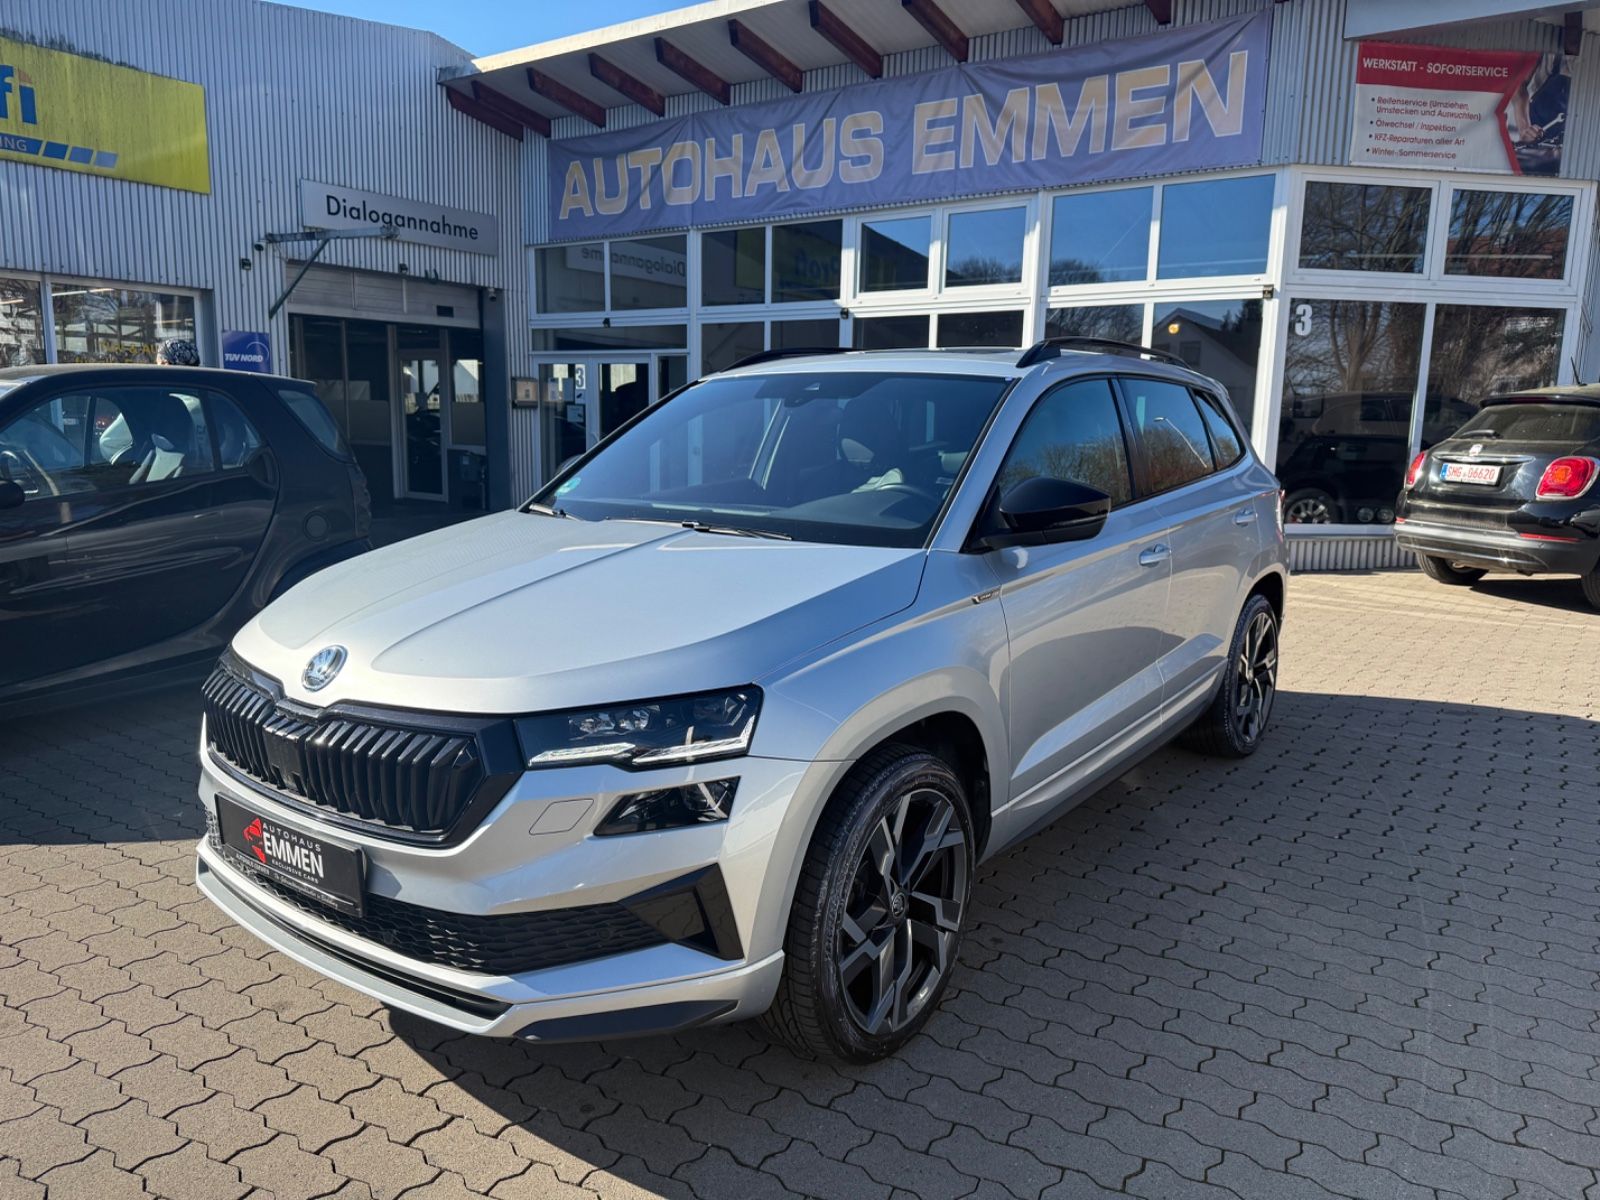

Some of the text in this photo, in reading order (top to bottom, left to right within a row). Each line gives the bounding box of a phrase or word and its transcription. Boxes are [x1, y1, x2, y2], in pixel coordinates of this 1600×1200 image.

[1362, 57, 1418, 72] WERKSTATT
[1426, 62, 1509, 78] SOFORTSERVICE
[1377, 96, 1428, 108] Reifenservice
[1421, 108, 1436, 117] und
[559, 50, 1249, 220] AUTOHAUS EMMEN
[1435, 137, 1453, 146] aller
[1454, 138, 1466, 147] Art
[325, 194, 479, 241] Dialogannahme
[1295, 304, 1313, 336] 3
[241, 354, 264, 363] NORD
[575, 367, 585, 388] 3
[262, 822, 322, 852] AUTOHAUS
[262, 832, 324, 879] EMMEN
